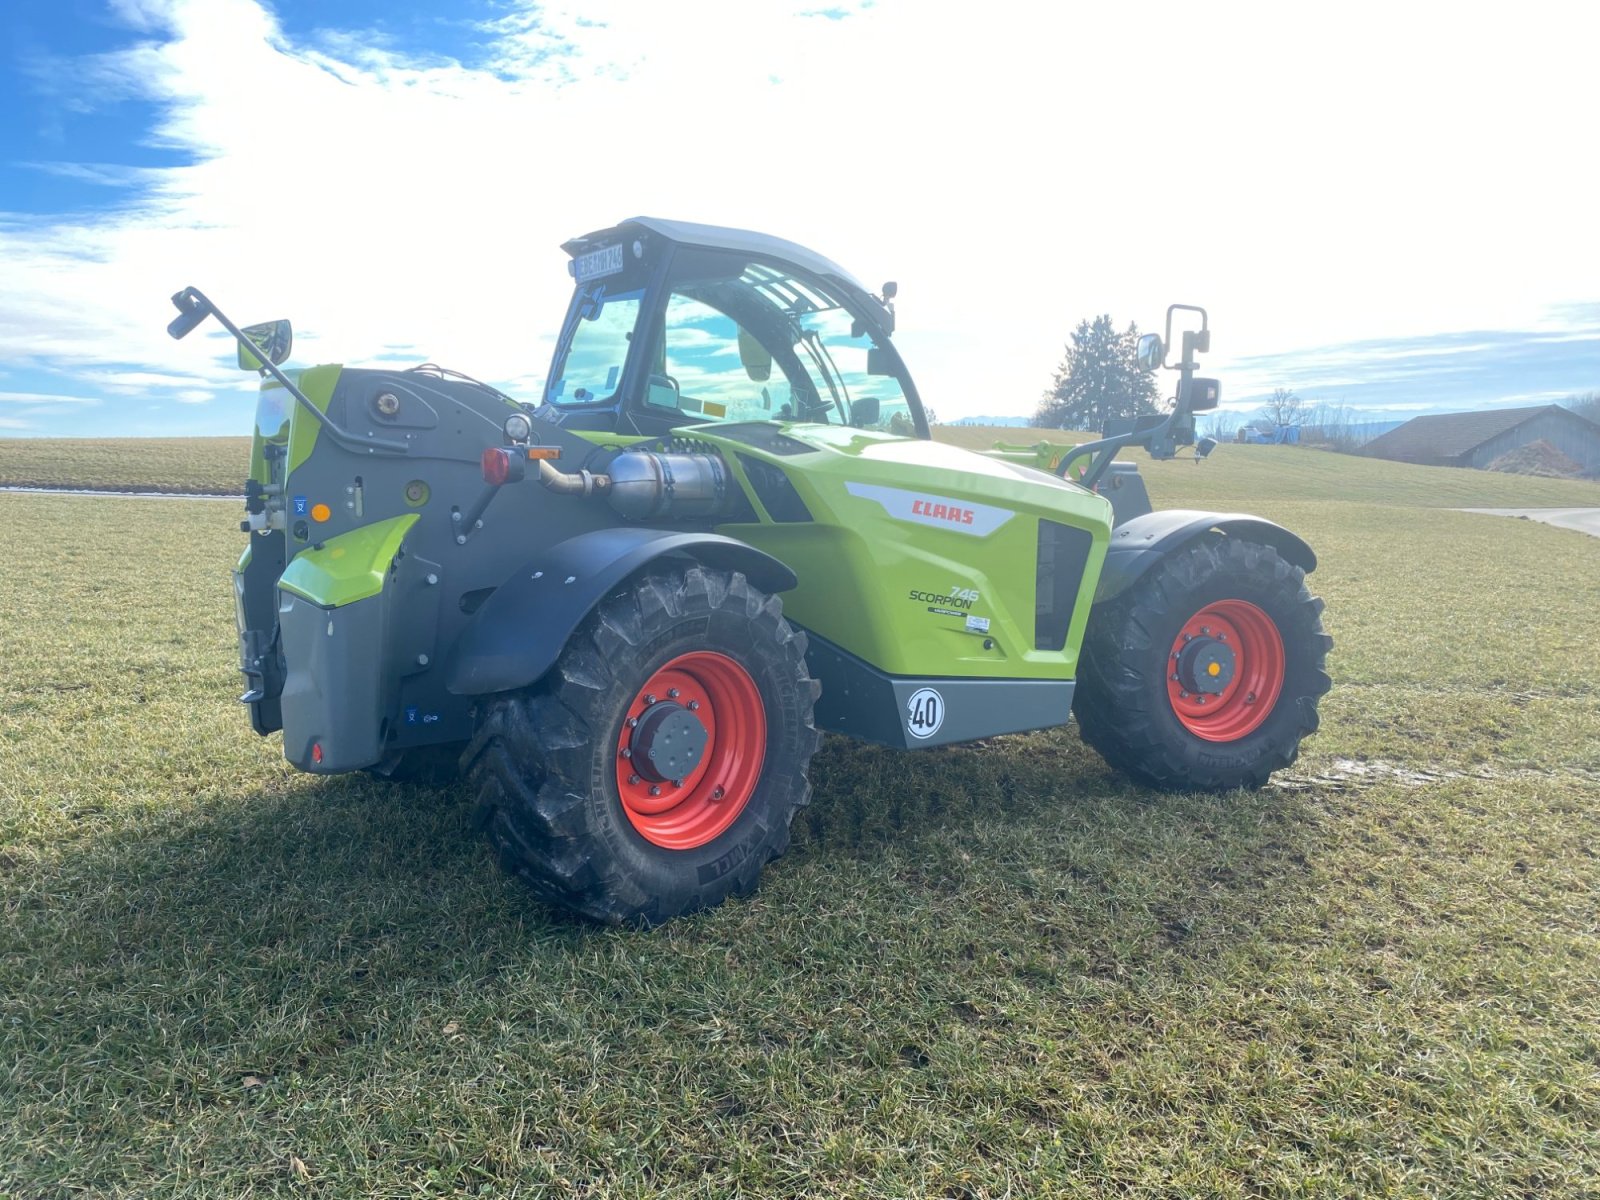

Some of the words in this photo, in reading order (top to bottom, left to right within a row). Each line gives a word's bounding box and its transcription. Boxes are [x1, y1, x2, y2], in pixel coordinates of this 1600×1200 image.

[912, 499, 974, 525] CLAAS
[908, 590, 973, 610] SCORPION
[949, 585, 980, 602] 746
[912, 697, 937, 729] 40
